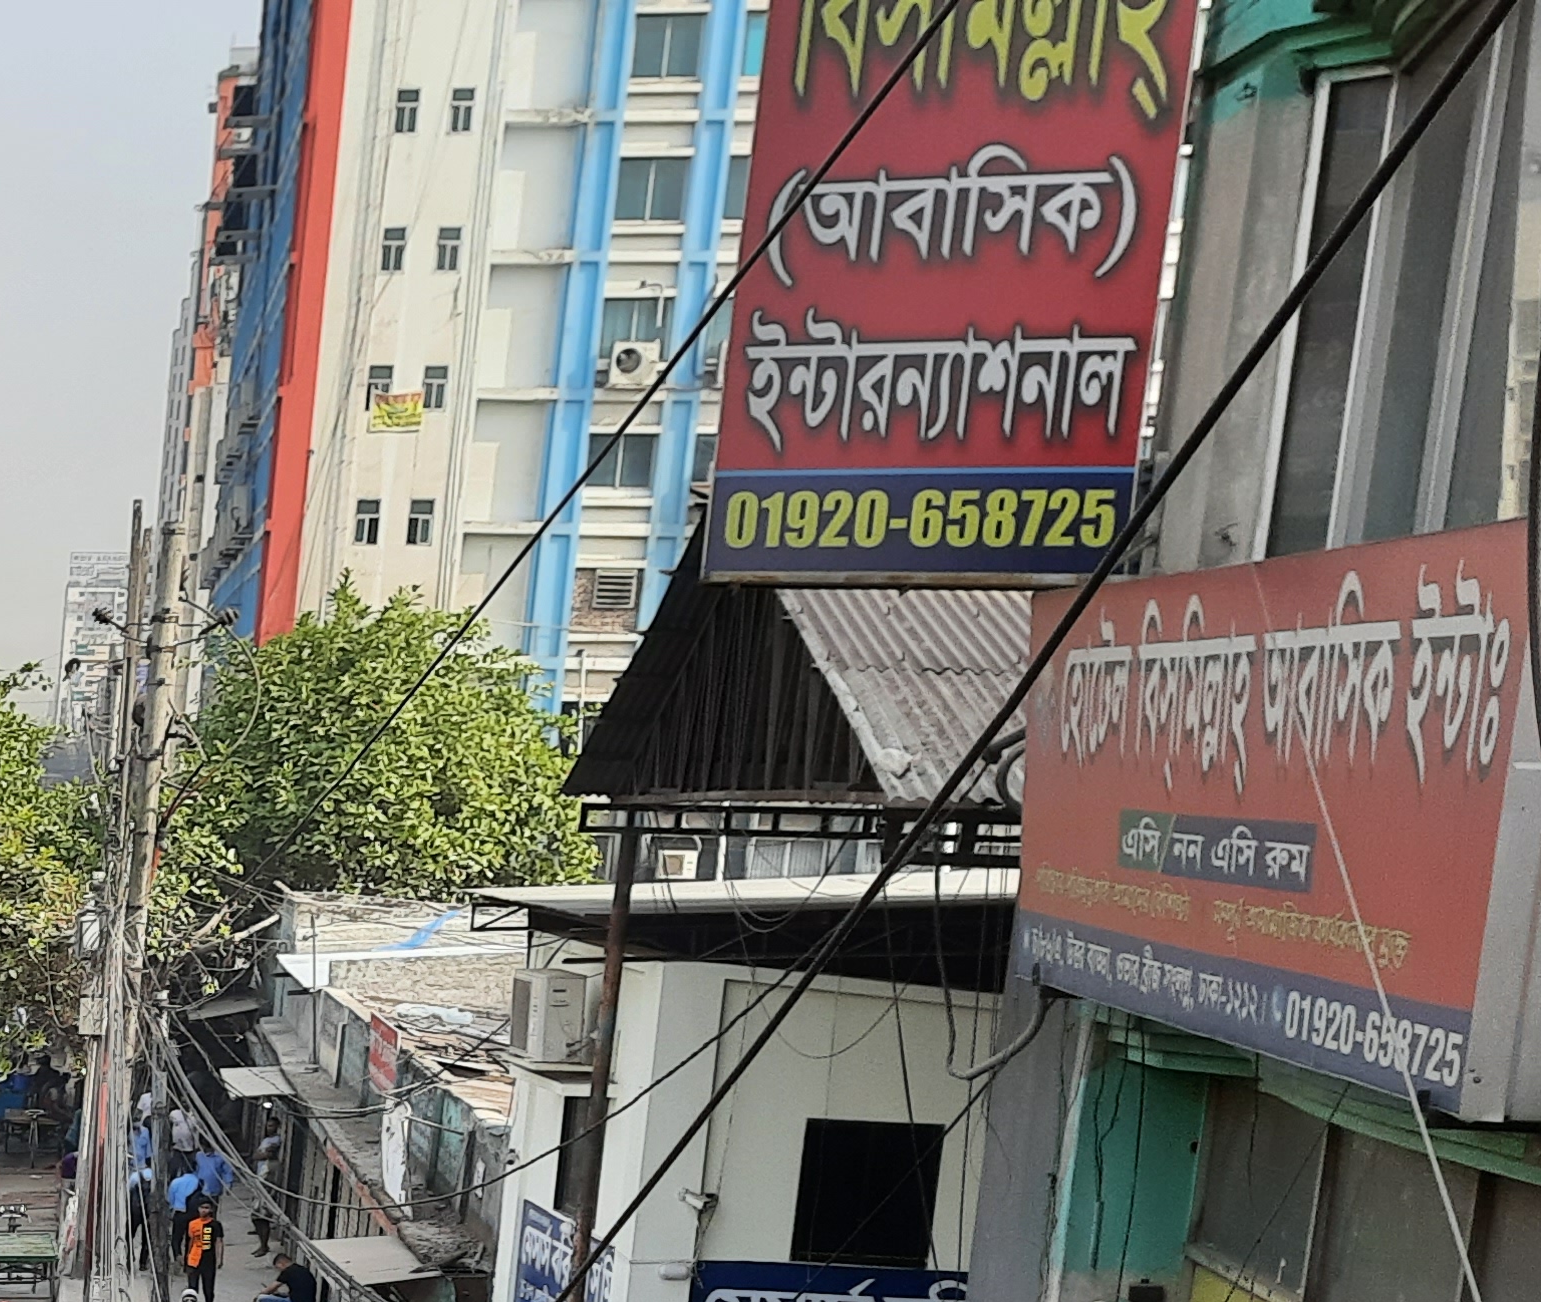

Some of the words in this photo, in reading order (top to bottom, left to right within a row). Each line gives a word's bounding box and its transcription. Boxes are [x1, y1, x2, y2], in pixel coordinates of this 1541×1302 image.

[767, 143, 1138, 287] (আবাসিক)
[745, 308, 1138, 454] ইন্টারন্যাশনাল
[725, 488, 1117, 551] 01920-658725
[1122, 816, 1162, 864] এসি
[1172, 832, 1205, 872] নন
[1211, 825, 1259, 876] এসি
[1284, 990, 1465, 1089] 01920-658725
